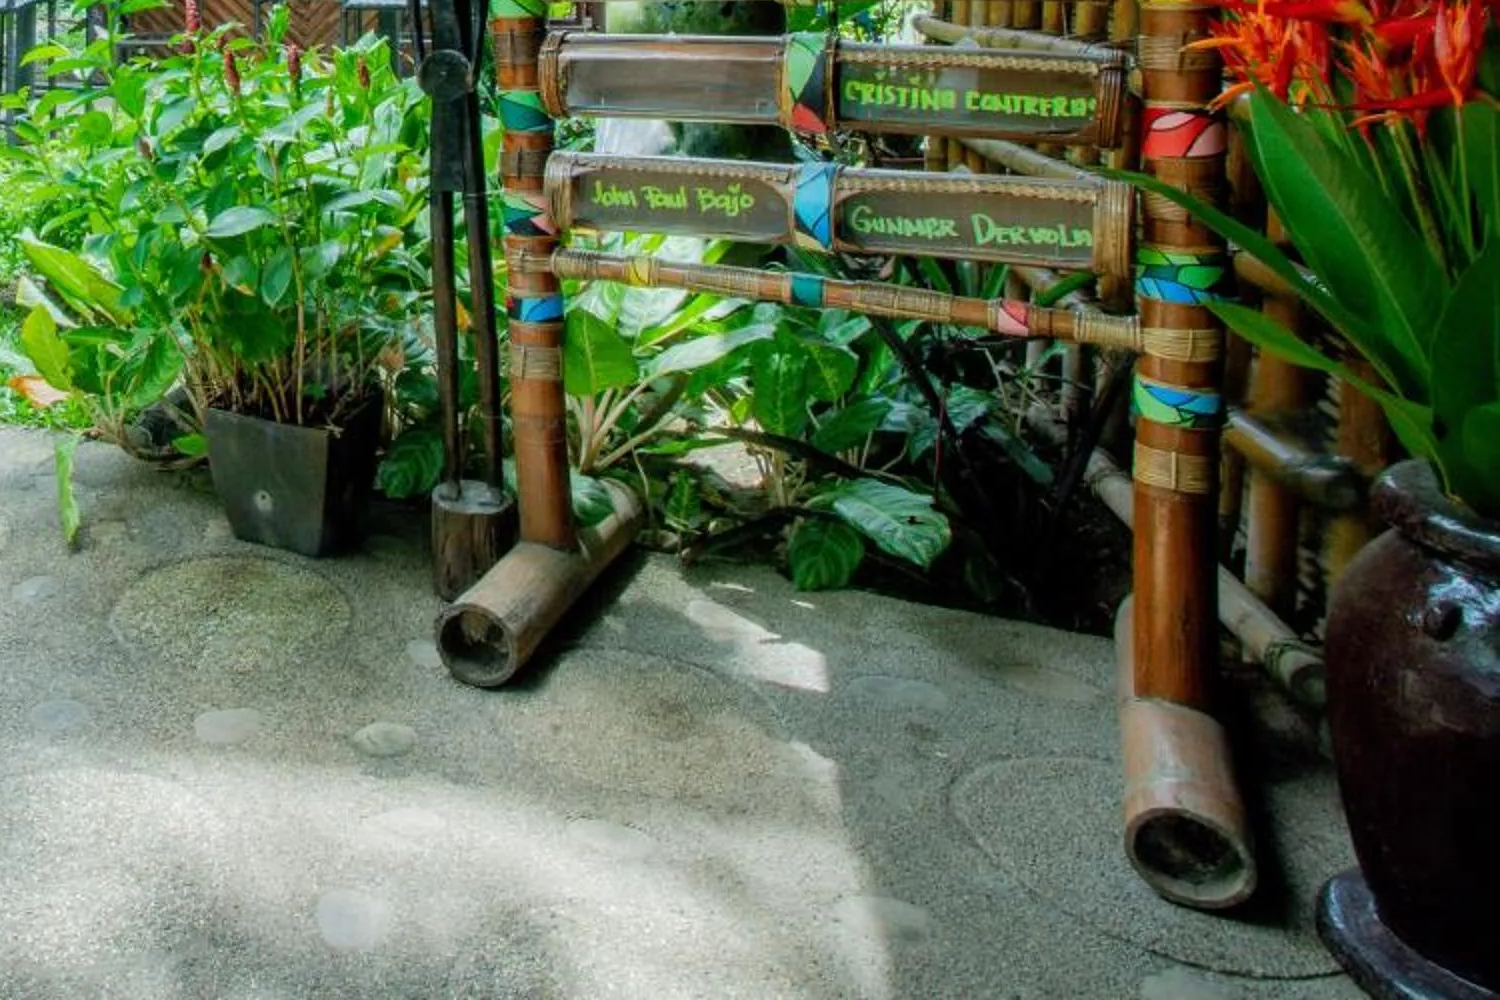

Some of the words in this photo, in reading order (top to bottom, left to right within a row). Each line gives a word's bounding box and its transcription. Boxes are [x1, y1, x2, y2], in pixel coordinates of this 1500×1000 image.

[592, 180, 637, 207] John
[640, 184, 688, 210] Paul
[696, 183, 755, 217] Bajo
